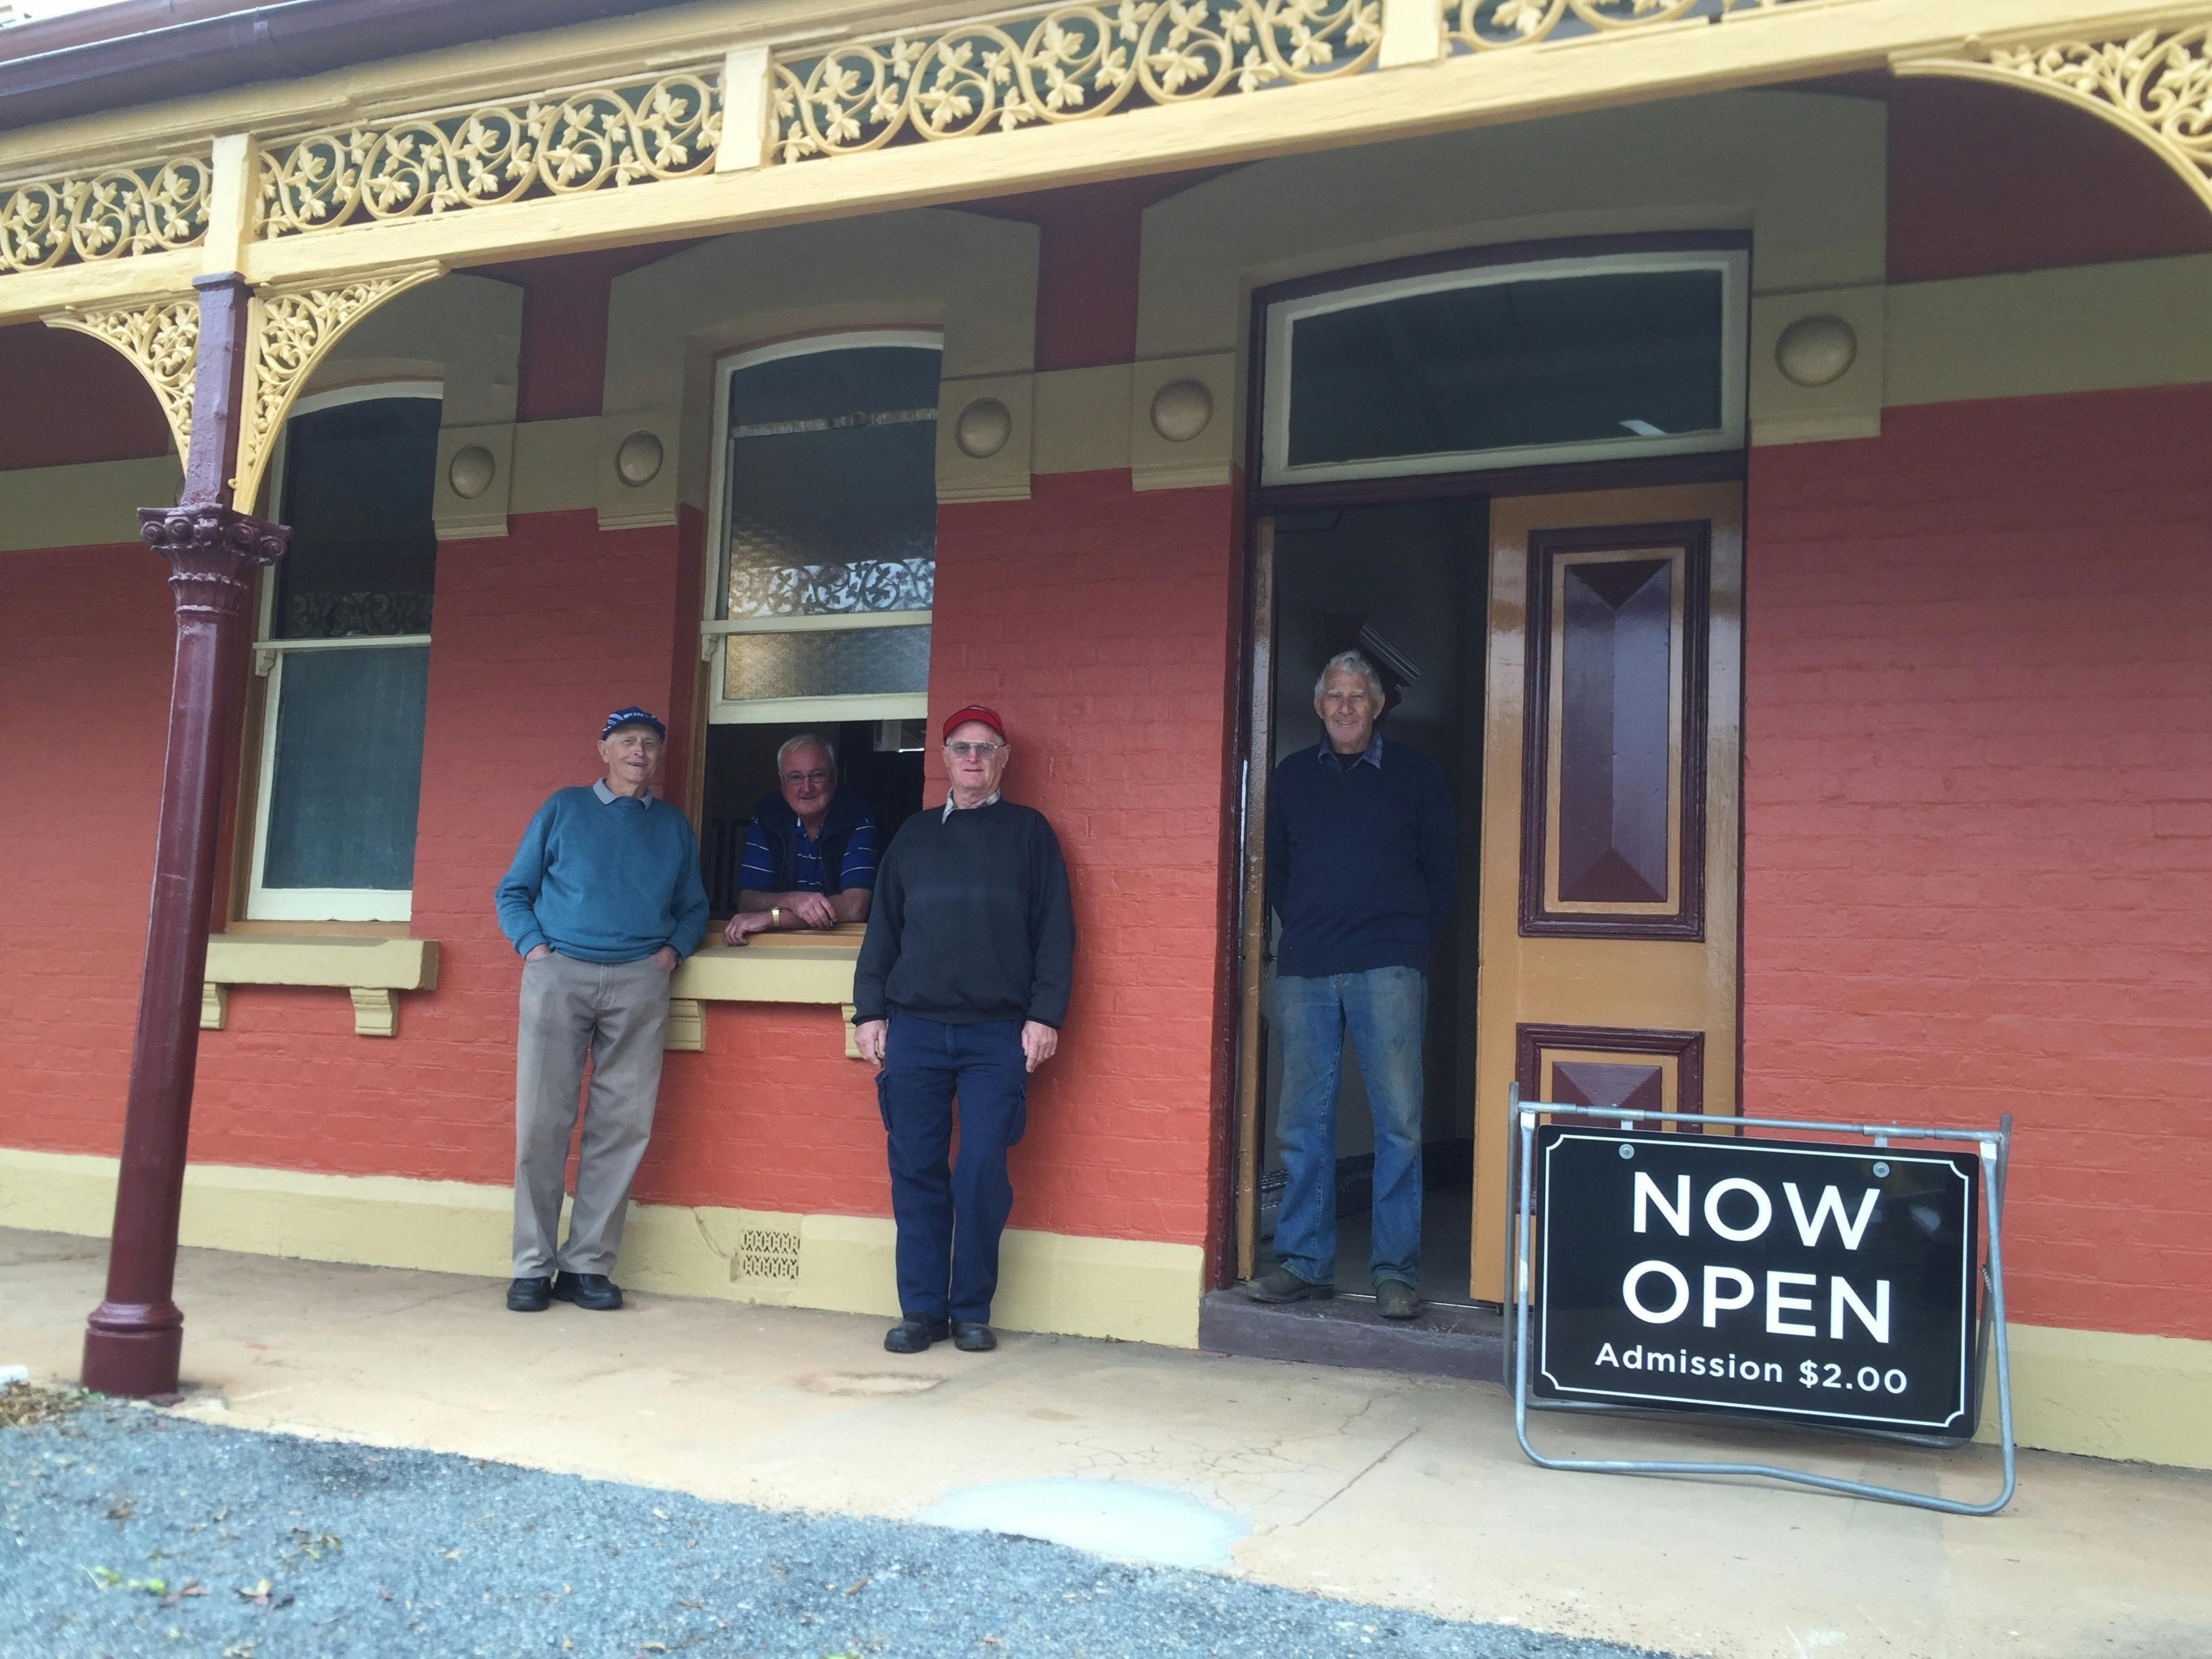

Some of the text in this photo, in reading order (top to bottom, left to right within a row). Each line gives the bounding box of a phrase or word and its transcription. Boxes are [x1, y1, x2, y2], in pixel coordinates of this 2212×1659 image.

[1633, 1171, 1881, 1250] NOW
[1622, 1260, 1891, 1344] OPEN
[1595, 1343, 1908, 1395] Admission $2.00
